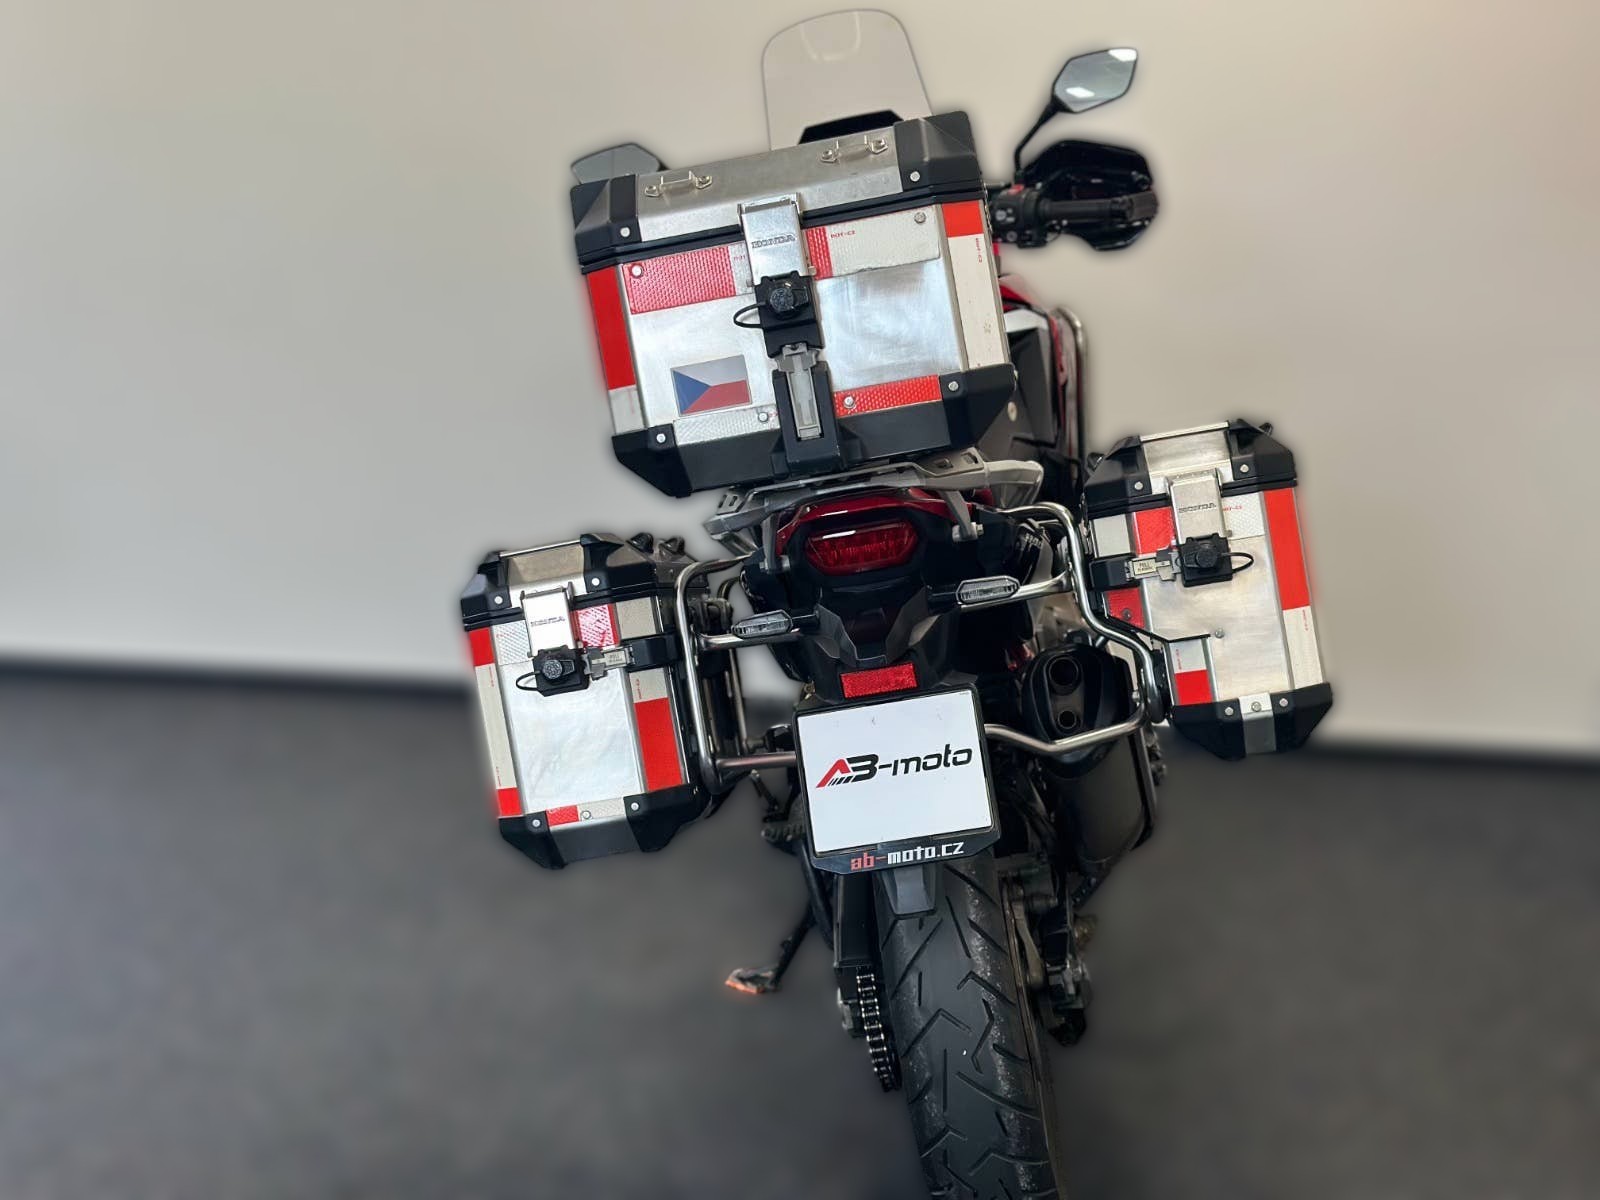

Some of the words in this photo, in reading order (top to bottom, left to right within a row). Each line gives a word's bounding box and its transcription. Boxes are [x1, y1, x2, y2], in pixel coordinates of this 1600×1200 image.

[751, 233, 797, 249] HONDA
[815, 743, 973, 789] AB-moto
[850, 841, 965, 871] ab-moto.cz
